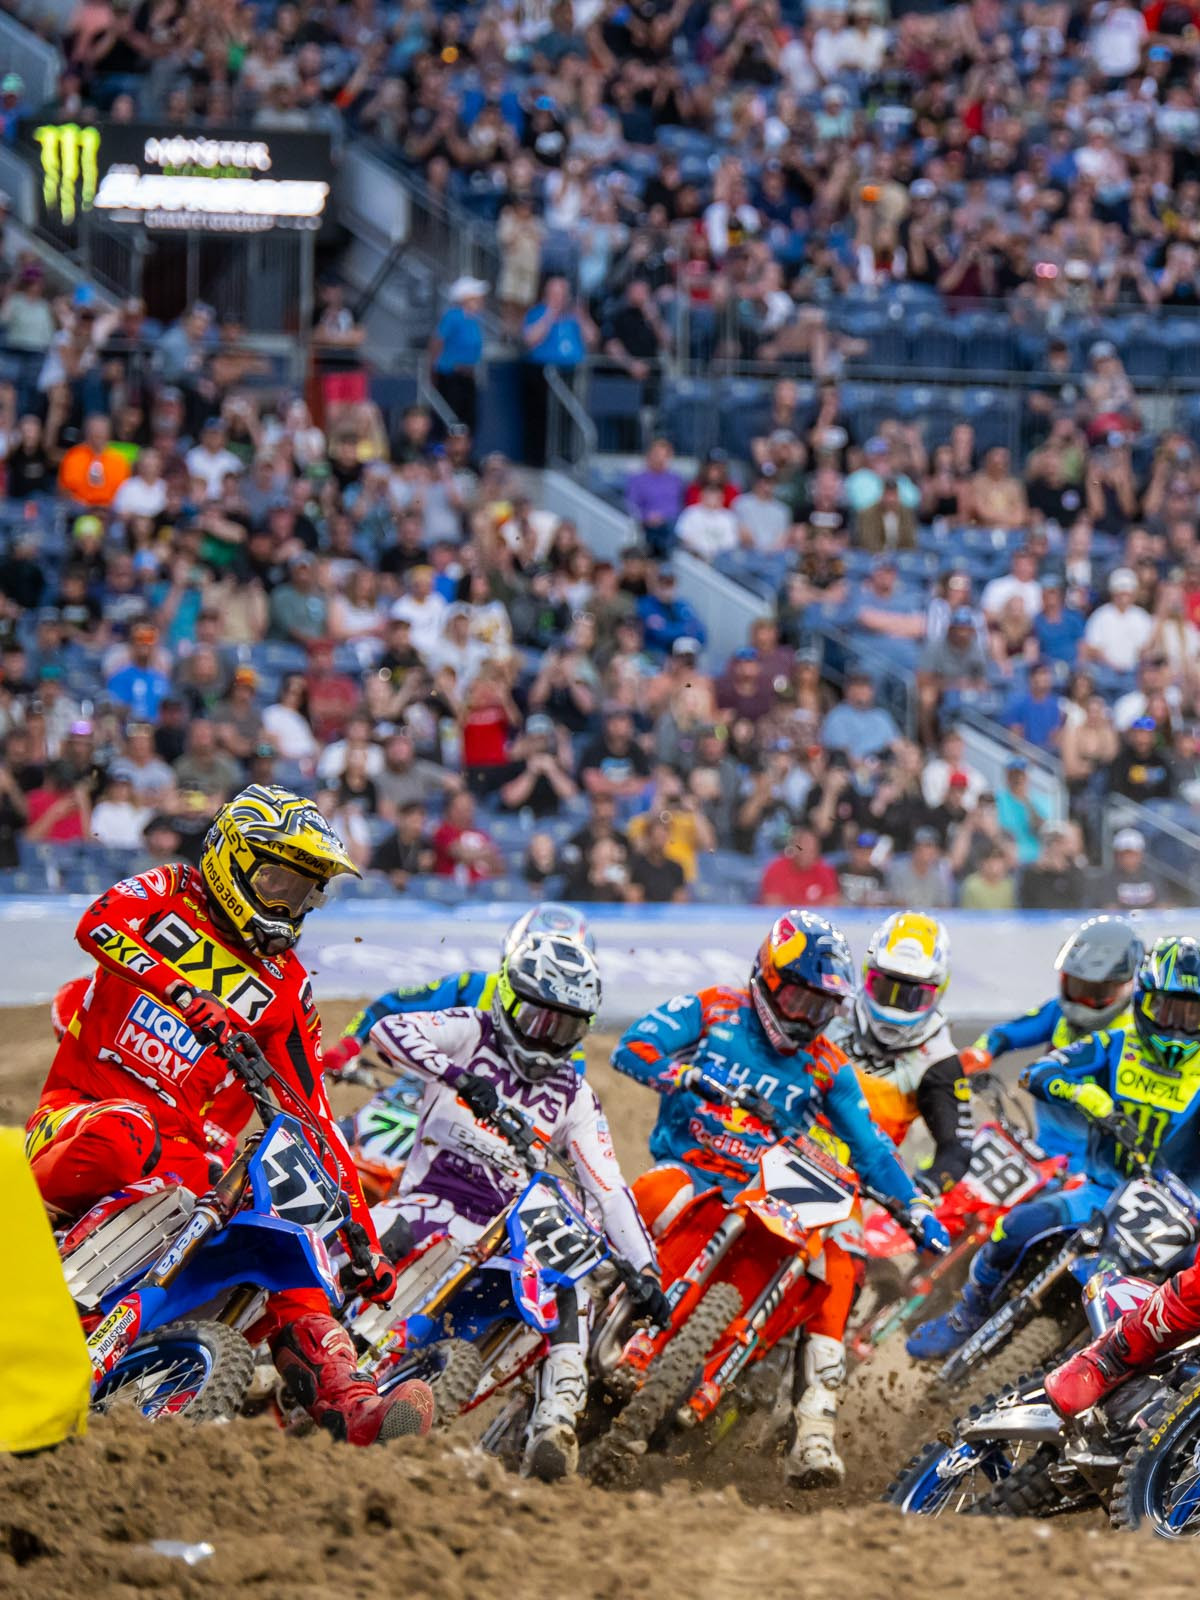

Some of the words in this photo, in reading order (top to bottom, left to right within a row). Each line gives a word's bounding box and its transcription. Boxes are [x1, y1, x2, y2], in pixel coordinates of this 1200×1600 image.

[204, 857, 245, 918] Insta360
[89, 923, 160, 975] FXR
[144, 910, 277, 1026] FXR
[119, 1023, 193, 1080] MOLY
[131, 998, 203, 1063] LIQUI
[767, 1159, 847, 1205] 7
[155, 1212, 211, 1277] Beta
